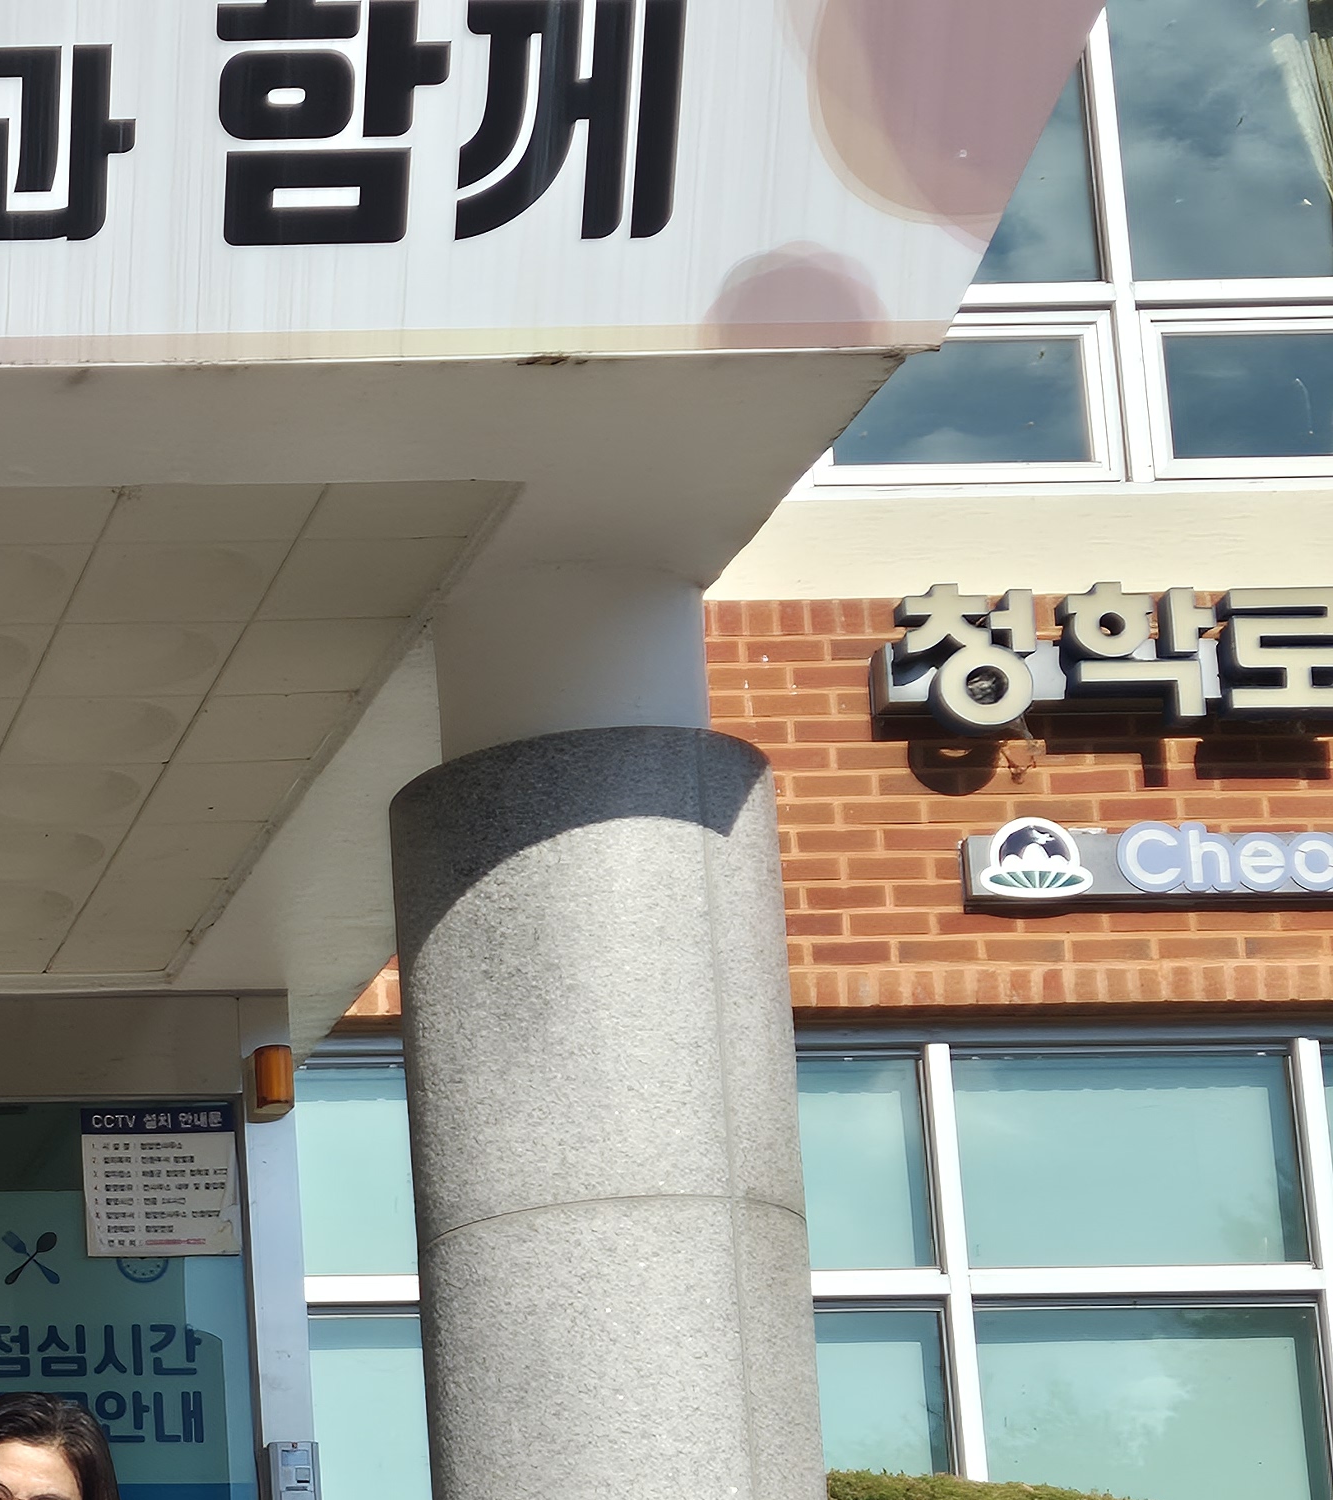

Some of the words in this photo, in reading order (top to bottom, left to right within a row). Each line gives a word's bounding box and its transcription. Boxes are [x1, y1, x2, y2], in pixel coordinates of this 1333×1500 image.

[215, 0, 686, 246] 함께
[91, 1114, 136, 1129] CCTV
[143, 1113, 172, 1129] 설치
[178, 1111, 223, 1128] 안내문
